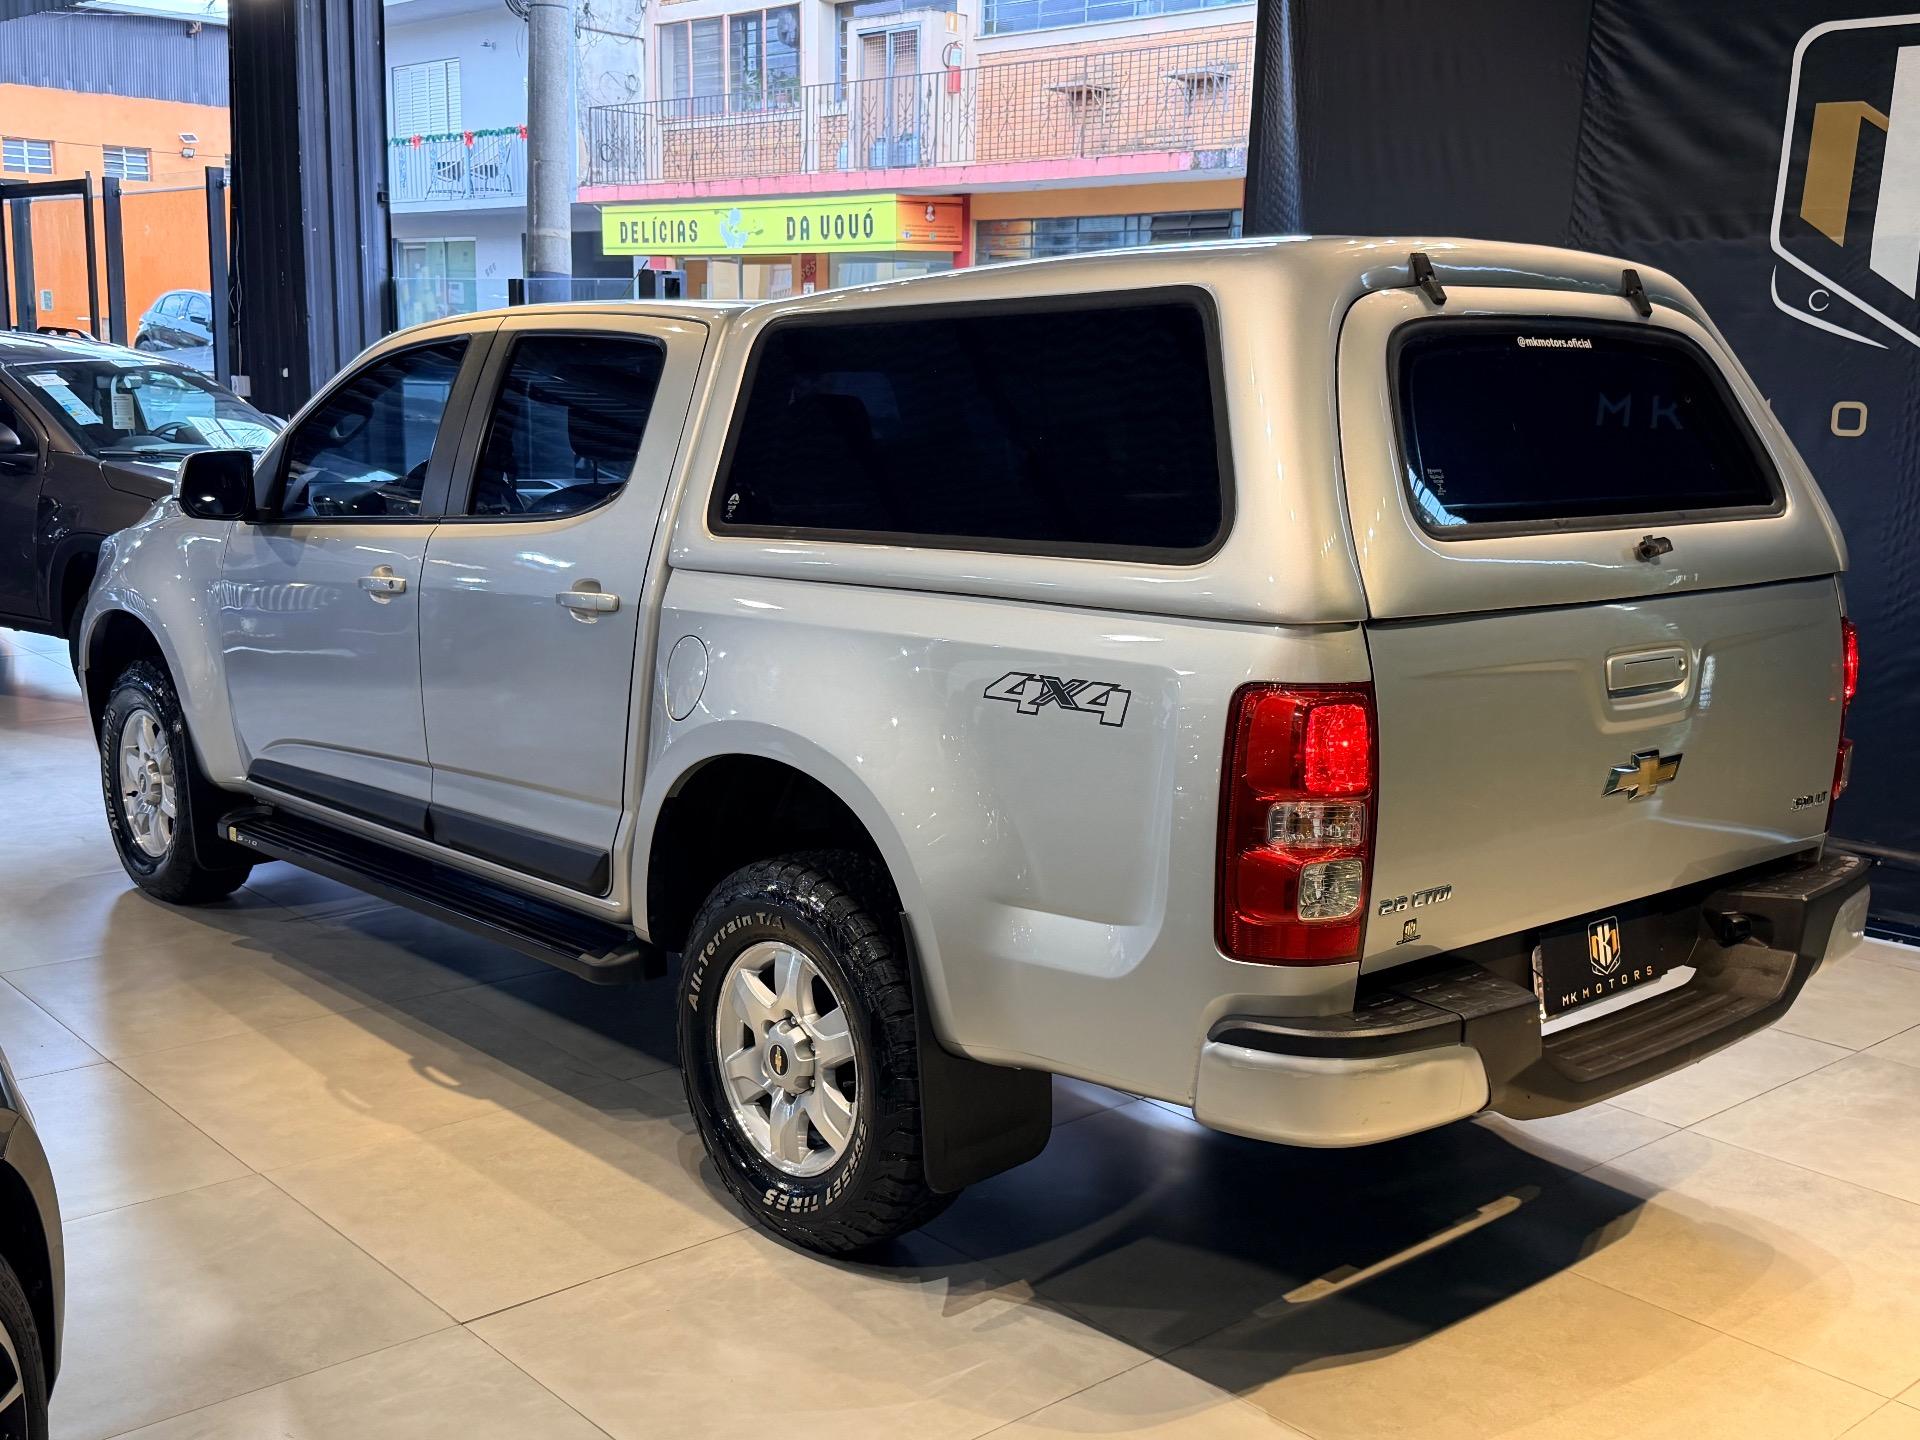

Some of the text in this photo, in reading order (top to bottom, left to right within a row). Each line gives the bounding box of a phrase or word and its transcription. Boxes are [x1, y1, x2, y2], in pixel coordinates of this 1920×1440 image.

[619, 216, 699, 244] DELÍCIAS
[786, 215, 811, 241] DA
[1517, 336, 1593, 349] @mkmotors.oficial
[688, 911, 786, 1013] All-Terrain T/A
[1561, 965, 1654, 1007] MK MOTORS
[762, 1188, 819, 1214] TIRES
